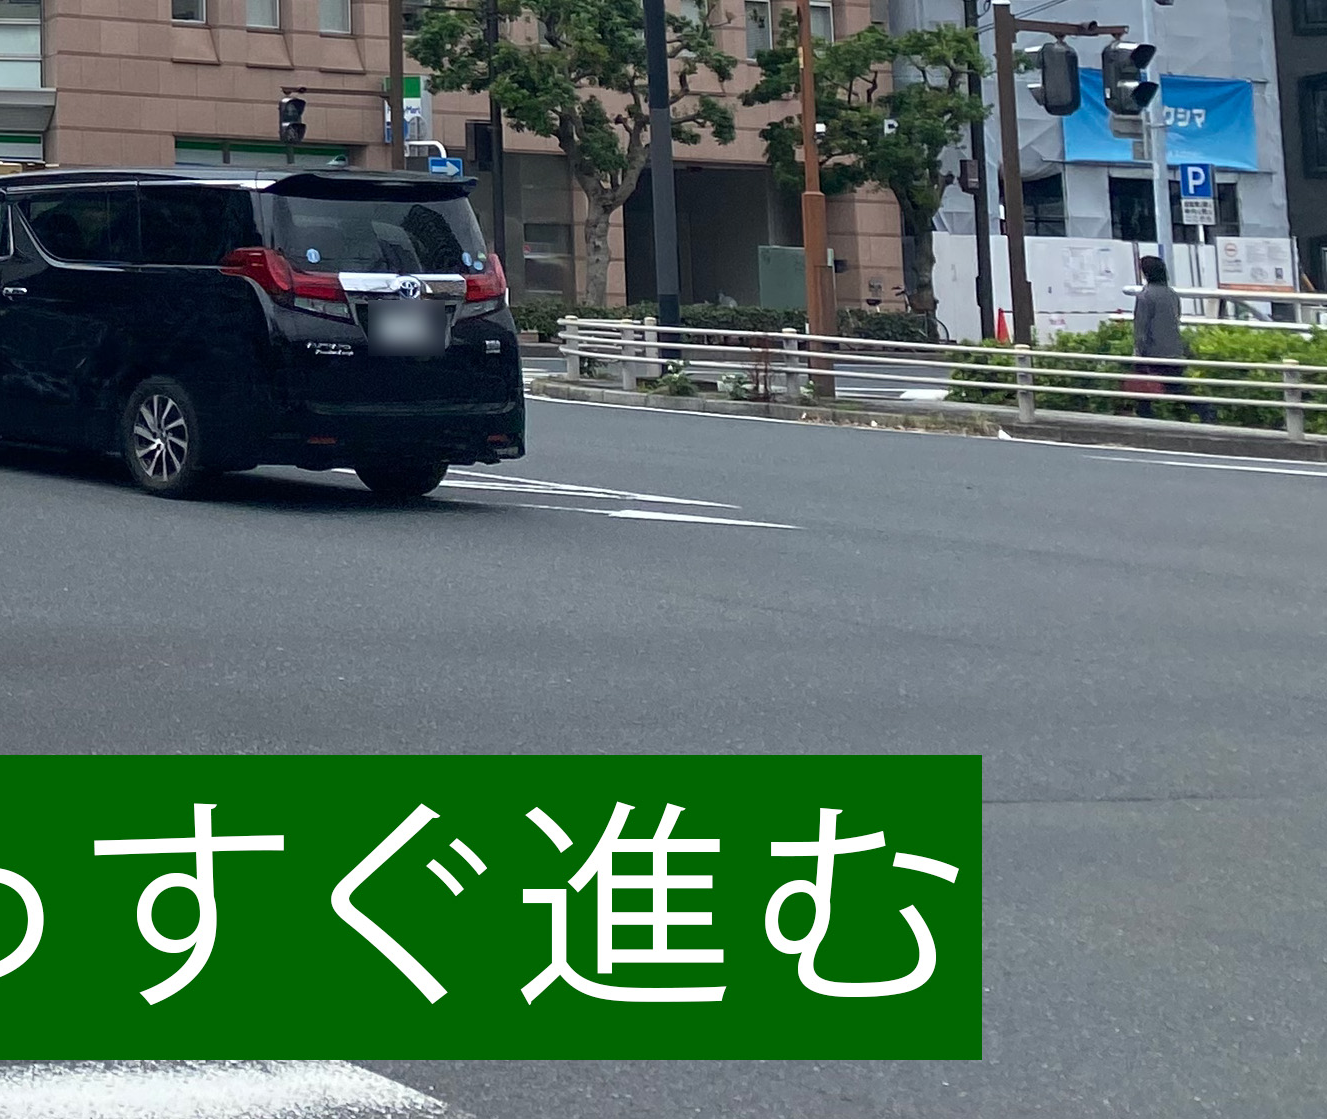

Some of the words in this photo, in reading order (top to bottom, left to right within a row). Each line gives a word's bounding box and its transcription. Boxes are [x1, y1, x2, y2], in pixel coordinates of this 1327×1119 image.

[1163, 105, 1207, 128] クシマ
[1187, 166, 1206, 195] P
